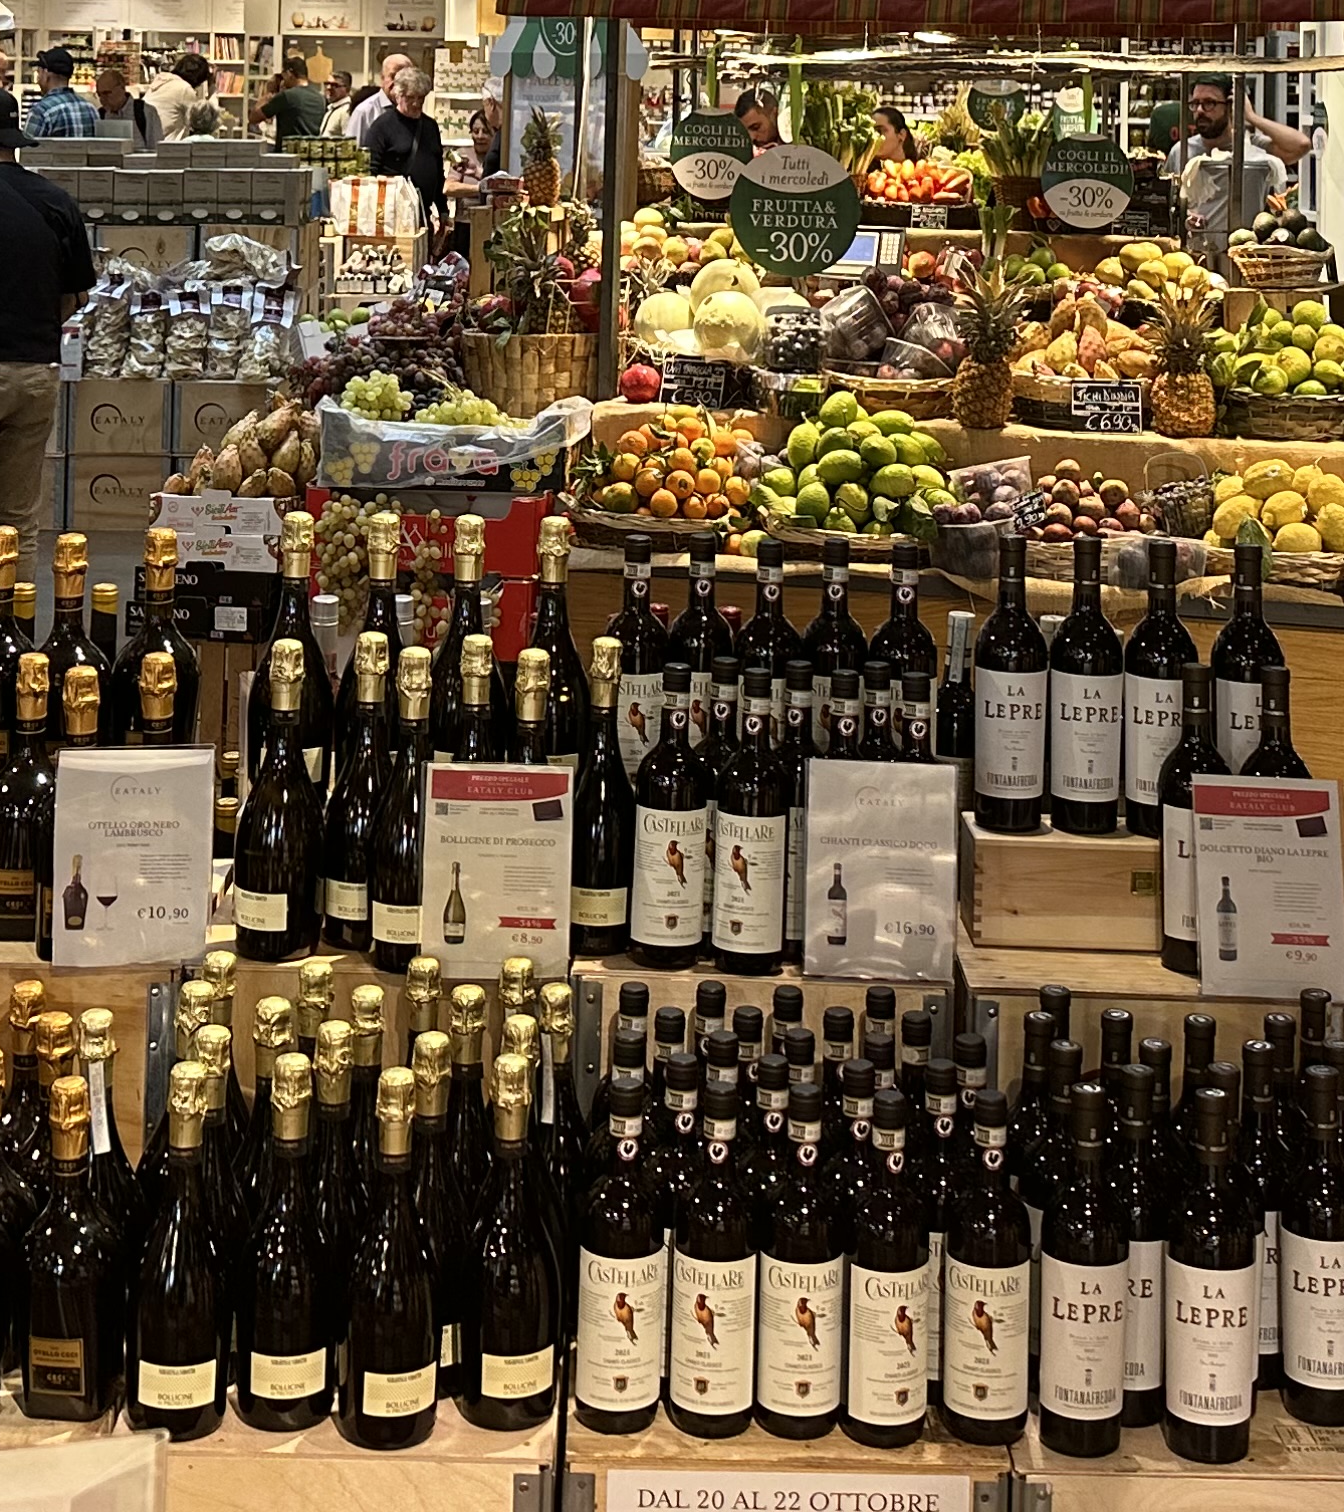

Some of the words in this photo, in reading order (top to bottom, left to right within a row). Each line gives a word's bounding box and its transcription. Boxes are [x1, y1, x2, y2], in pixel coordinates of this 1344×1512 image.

[684, 124, 723, 136] COGLI
[727, 124, 740, 136] IL
[686, 158, 735, 181] -30%
[780, 155, 810, 170] Tutti
[768, 172, 829, 186] mercoledì
[752, 199, 837, 214] FRUTTA&
[749, 213, 838, 229] VERDURA
[756, 231, 833, 264] -30%
[95, 416, 145, 425] EATALY
[387, 441, 499, 481] fraa
[1006, 685, 1026, 697] LA
[984, 699, 1043, 720] LEPRE
[88, 821, 128, 830] OTELLO
[153, 820, 180, 829] NERO
[104, 829, 164, 838] LAMBRUSCO
[440, 835, 491, 846] BOLLICINE
[493, 837, 503, 846] DI
[505, 838, 556, 847] PROSECCO
[820, 836, 860, 846] CHIANTI
[862, 838, 908, 849] CLASSICO
[1200, 844, 1252, 854] DOLCETTO
[1254, 846, 1286, 856] DIANO
[1286, 848, 1300, 856] LA
[1300, 848, 1329, 858] LEPRE
[1256, 855, 1274, 863] BIO
[674, 1257, 745, 1290] CASTELLARE
[949, 1265, 1020, 1295] CASTELLARE
[1080, 1280, 1103, 1295] LA
[1202, 1284, 1226, 1300] LA
[1051, 1296, 1124, 1324] LEPRE
[1175, 1299, 1249, 1328] LEPRE
[1054, 1384, 1117, 1406] FONTANAFREDDA
[1179, 1389, 1243, 1412] FONTANAFREDDA
[637, 1488, 690, 1510] DAL
[697, 1489, 725, 1510] 20
[732, 1490, 768, 1511] AL
[773, 1491, 801, 1511] 22
[809, 1491, 940, 1512] OTTOBRE
